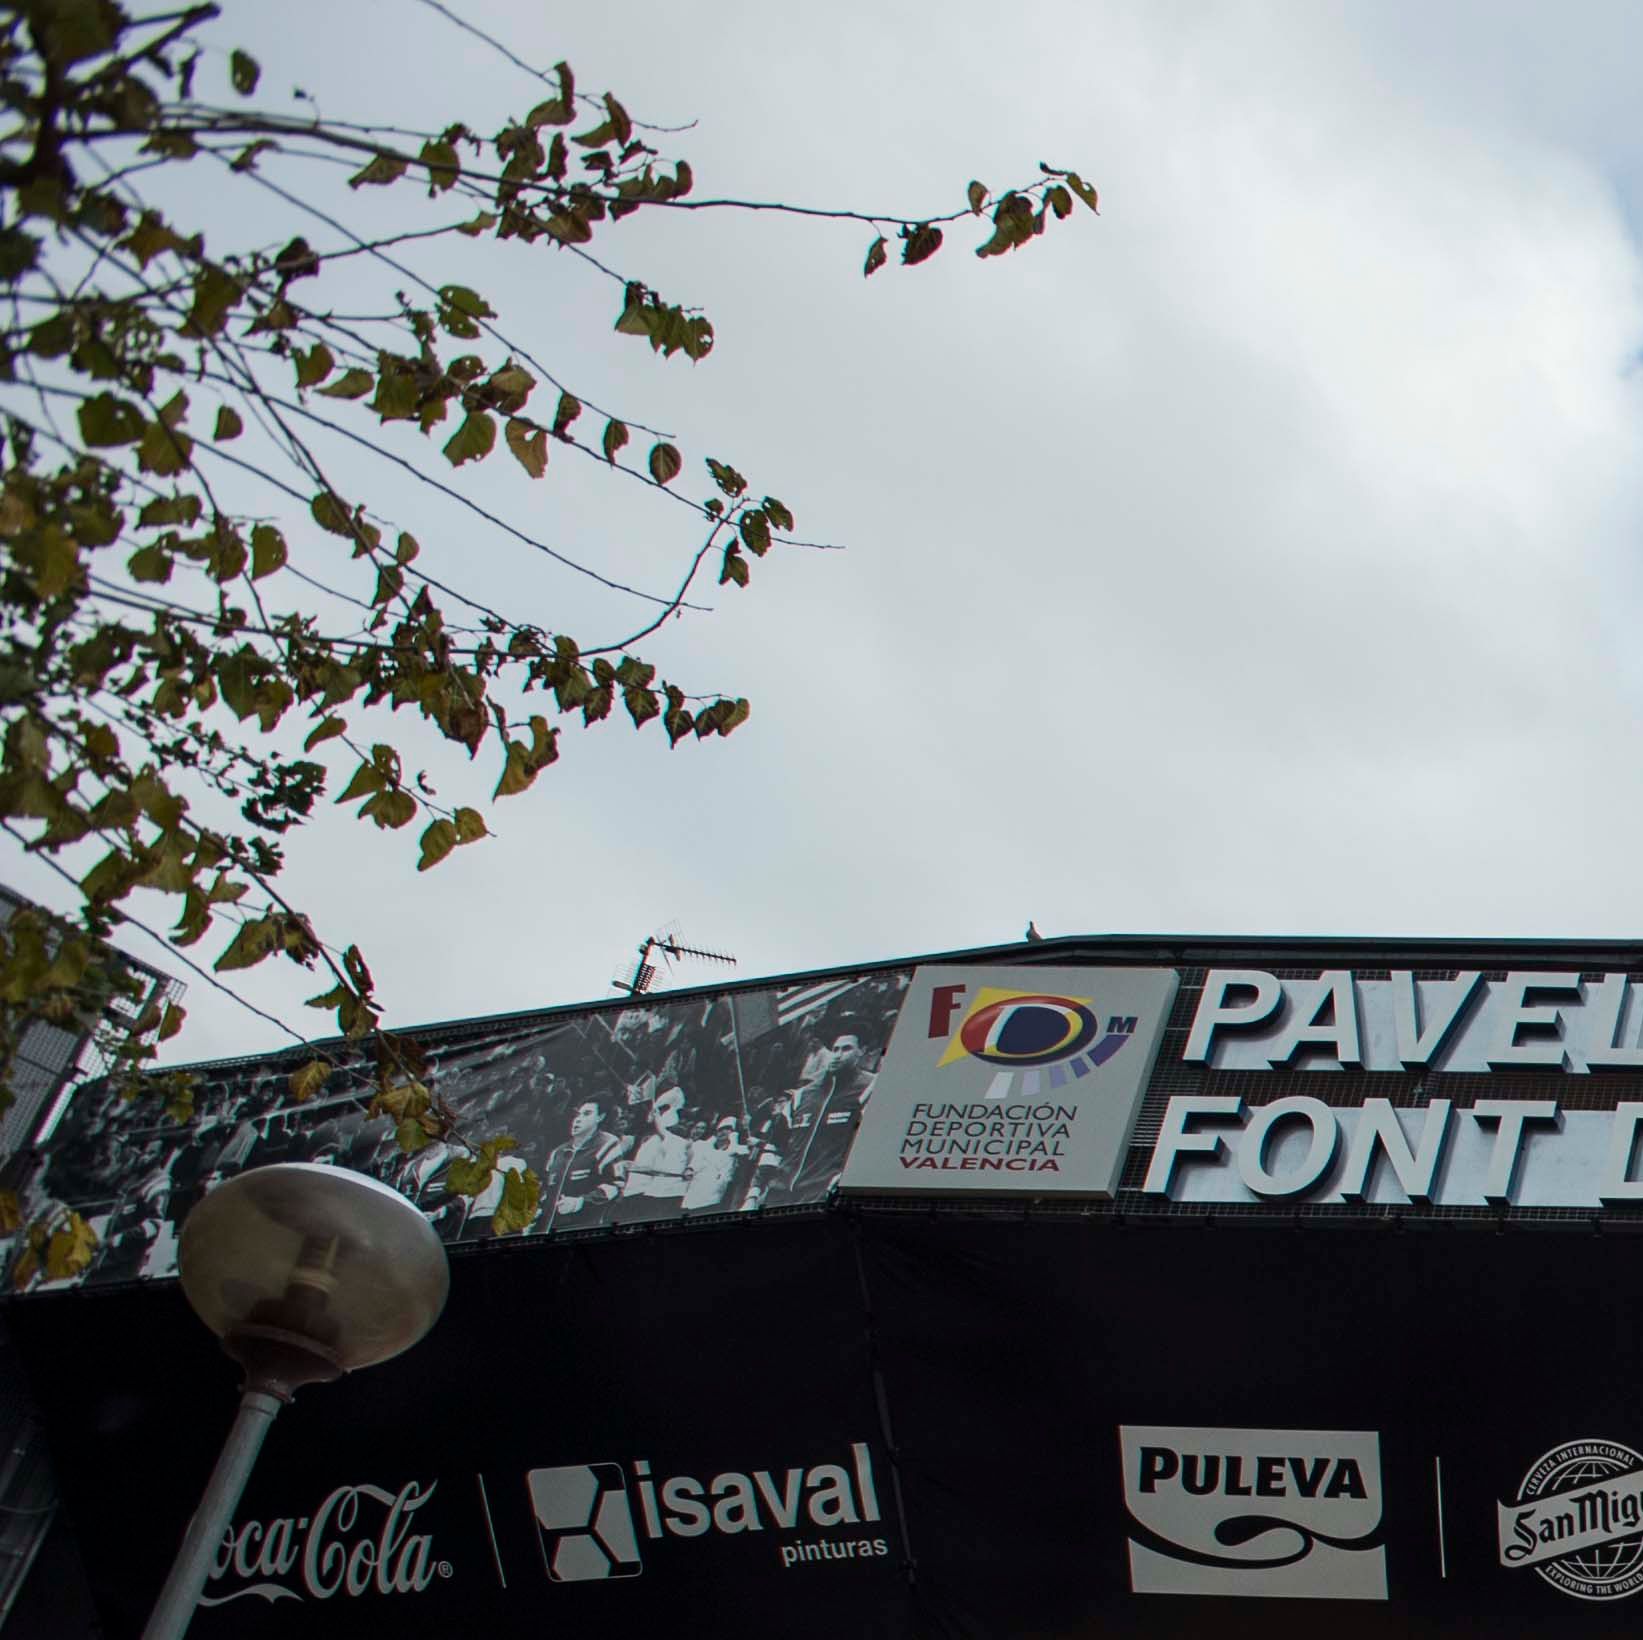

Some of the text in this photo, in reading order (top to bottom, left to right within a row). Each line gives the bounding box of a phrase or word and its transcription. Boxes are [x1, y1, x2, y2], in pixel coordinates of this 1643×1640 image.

[906, 1121, 1071, 1138] DEPORTIVA
[912, 1102, 1078, 1121] FUNDACIÓN
[899, 1157, 1060, 1171] VALENCIA
[900, 1139, 1065, 1156] MUNICIPAL
[1142, 1095, 1562, 1206] FONT
[1139, 1446, 1368, 1499] PULEVA
[1526, 1445, 1635, 1495] CERVEZA INTERNACIONAL
[633, 1442, 881, 1538] isaval
[185, 1479, 438, 1606] oca-Cola
[781, 1538, 889, 1567] pinturas
[1504, 1508, 1574, 1561] San
[1545, 1566, 1593, 1594] EXPLORING
[1596, 1585, 1613, 1595] THE
[1614, 1574, 1643, 1593] WORLD
